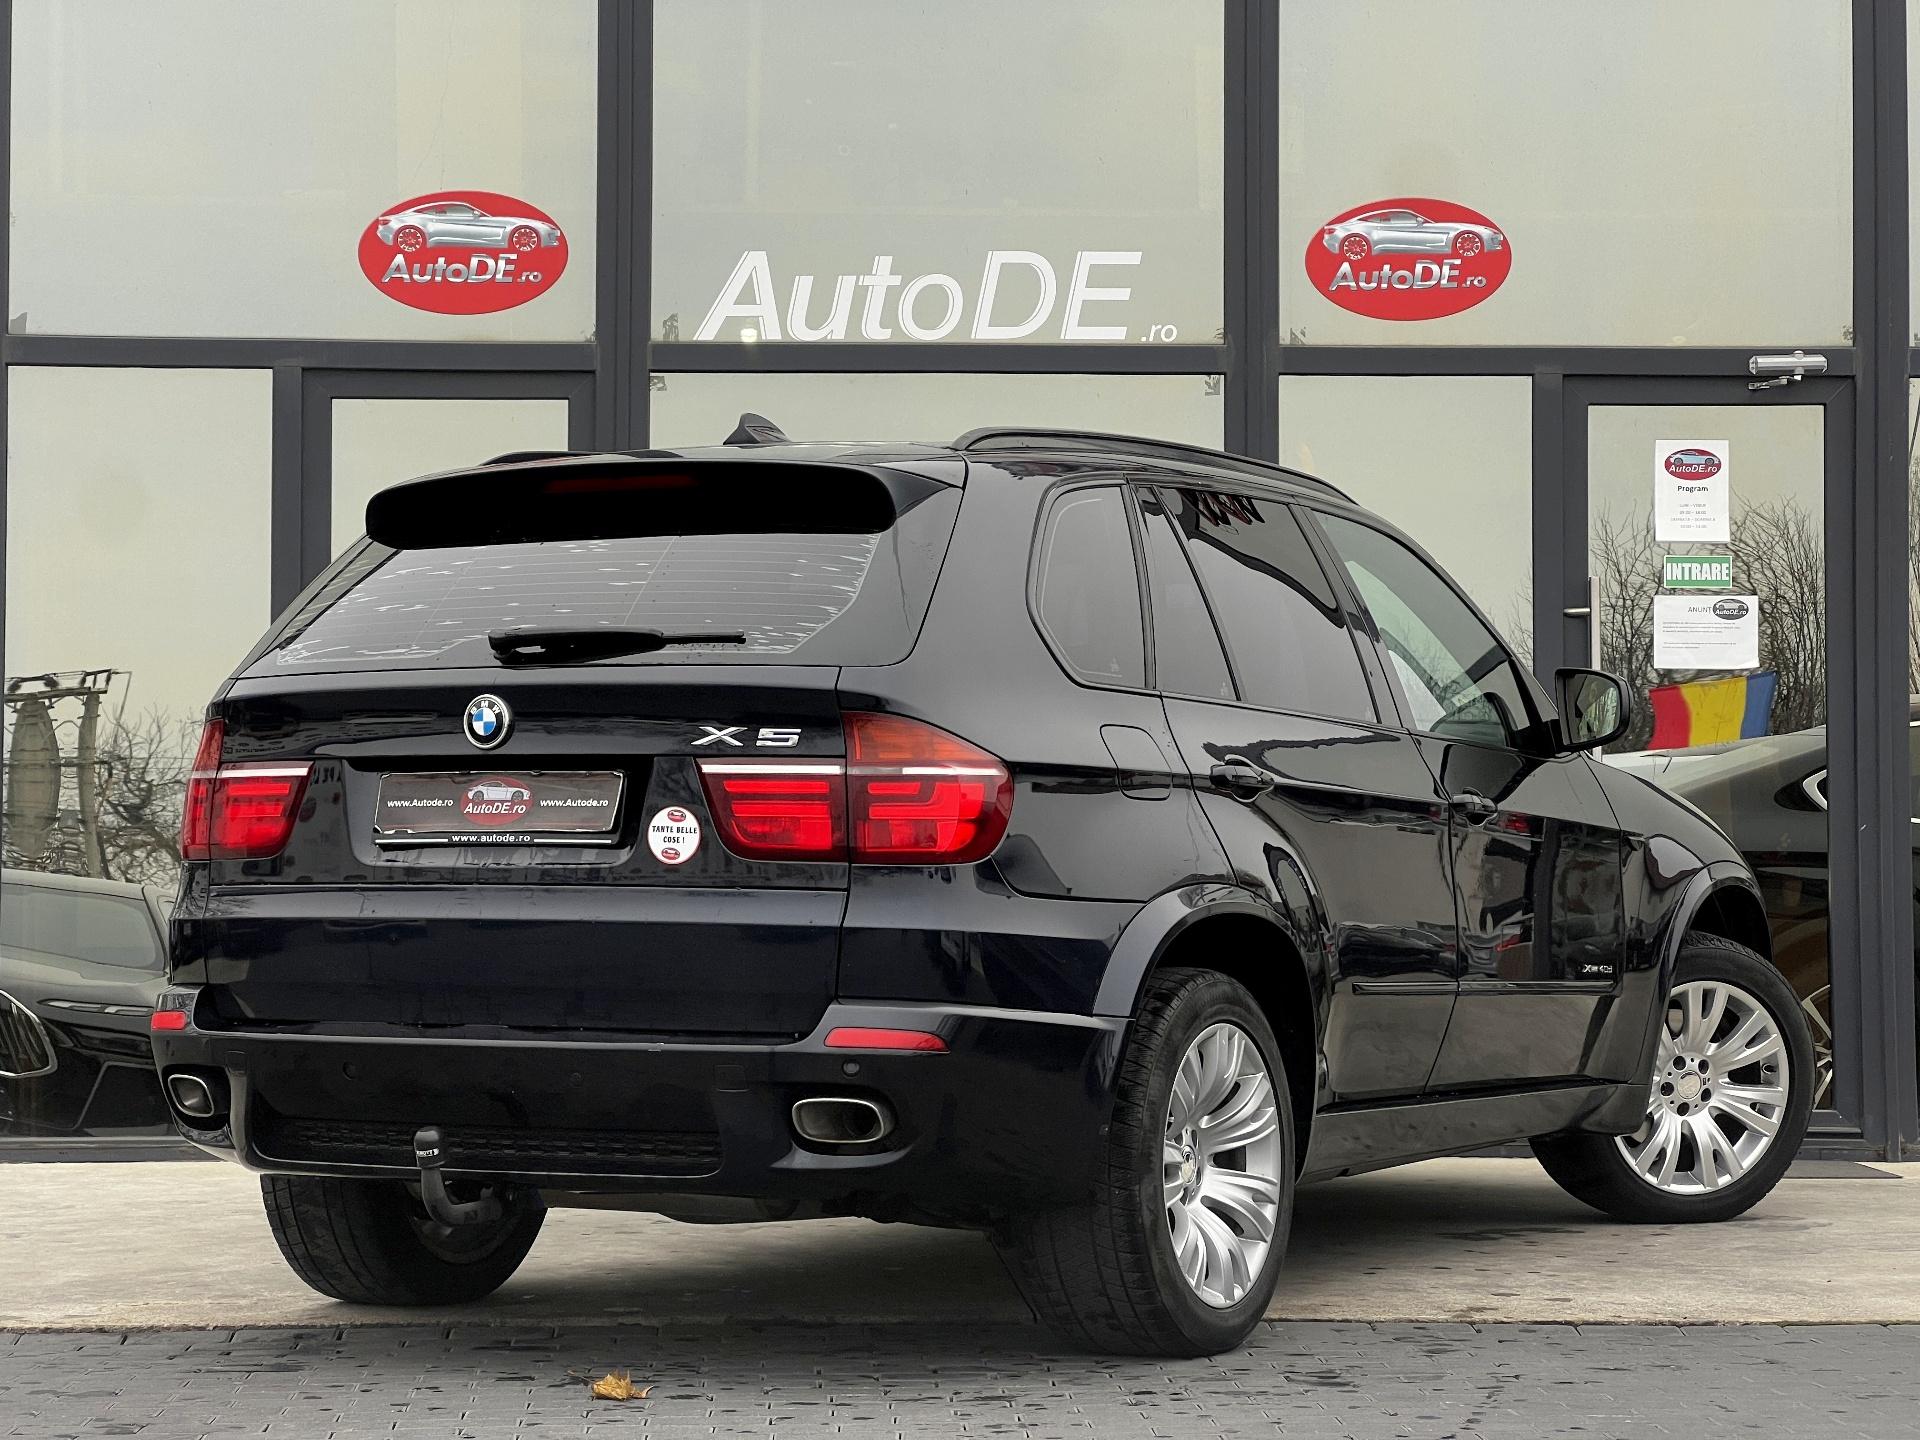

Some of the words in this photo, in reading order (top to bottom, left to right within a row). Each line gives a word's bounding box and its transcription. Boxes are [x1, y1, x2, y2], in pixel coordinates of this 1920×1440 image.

[1669, 465, 1718, 473] AutoDE.ro
[1677, 485, 1709, 493] Program
[1666, 562, 1730, 581] INTRARE
[470, 700, 501, 715] BMW
[387, 798, 454, 808] www.Autode.ro
[540, 798, 609, 807] www.Autode.ro
[463, 802, 526, 814] AutoDE.ro
[652, 825, 674, 833] TANTE
[676, 826, 698, 834] BELLE
[452, 834, 531, 842] www.autode.ro
[663, 836, 680, 844] COSE
